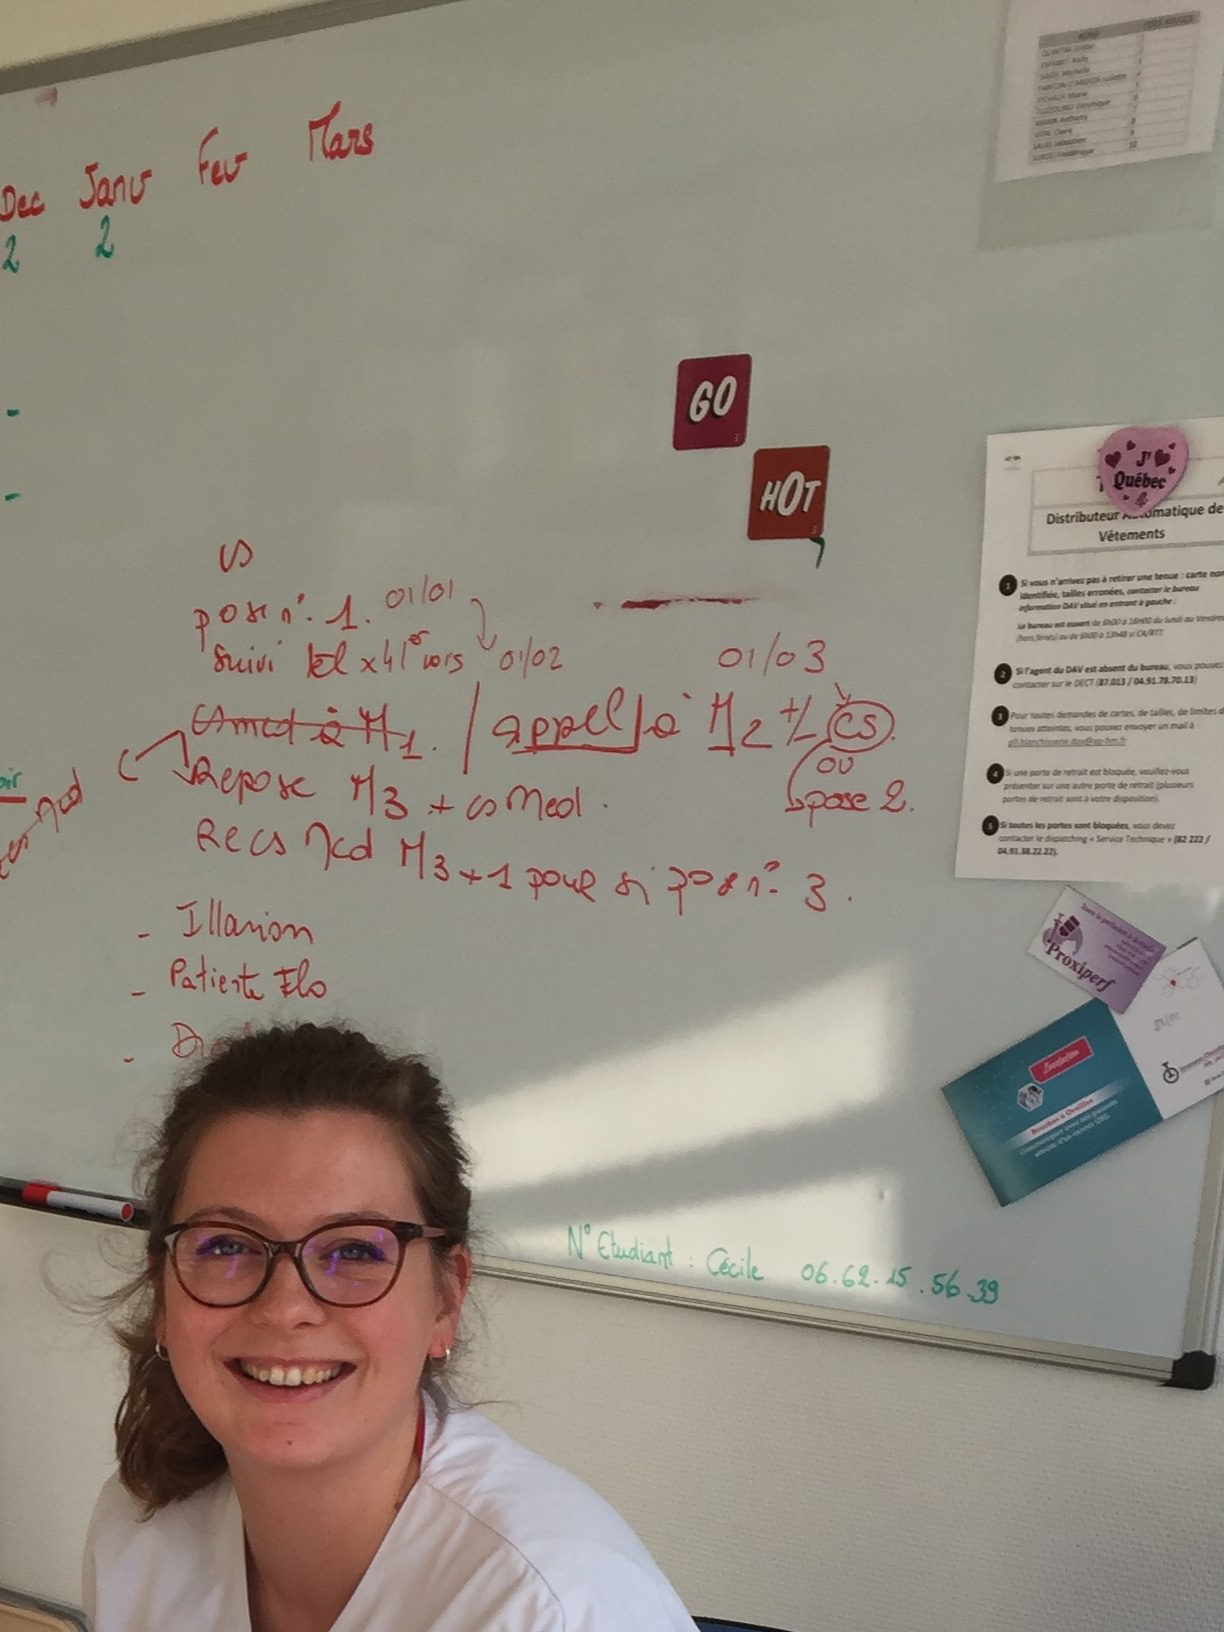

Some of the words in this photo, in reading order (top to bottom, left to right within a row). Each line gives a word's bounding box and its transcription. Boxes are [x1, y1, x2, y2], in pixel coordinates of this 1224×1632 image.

[308, 101, 373, 162] Mars
[2, 235, 19, 273] 2
[95, 215, 114, 258] 2
[689, 376, 737, 422] GO
[759, 471, 821, 516] HOT
[1113, 471, 1166, 490] Québec
[1047, 512, 1119, 525] Distributeur
[1122, 507, 1204, 519] Aomatique
[1099, 529, 1165, 542] Vêtements
[1086, 577, 1100, 586] pas
[1109, 574, 1135, 582] retirer
[1155, 571, 1178, 580] tenue
[718, 632, 827, 676] 01/03
[1046, 941, 1116, 993] Proxiperf
